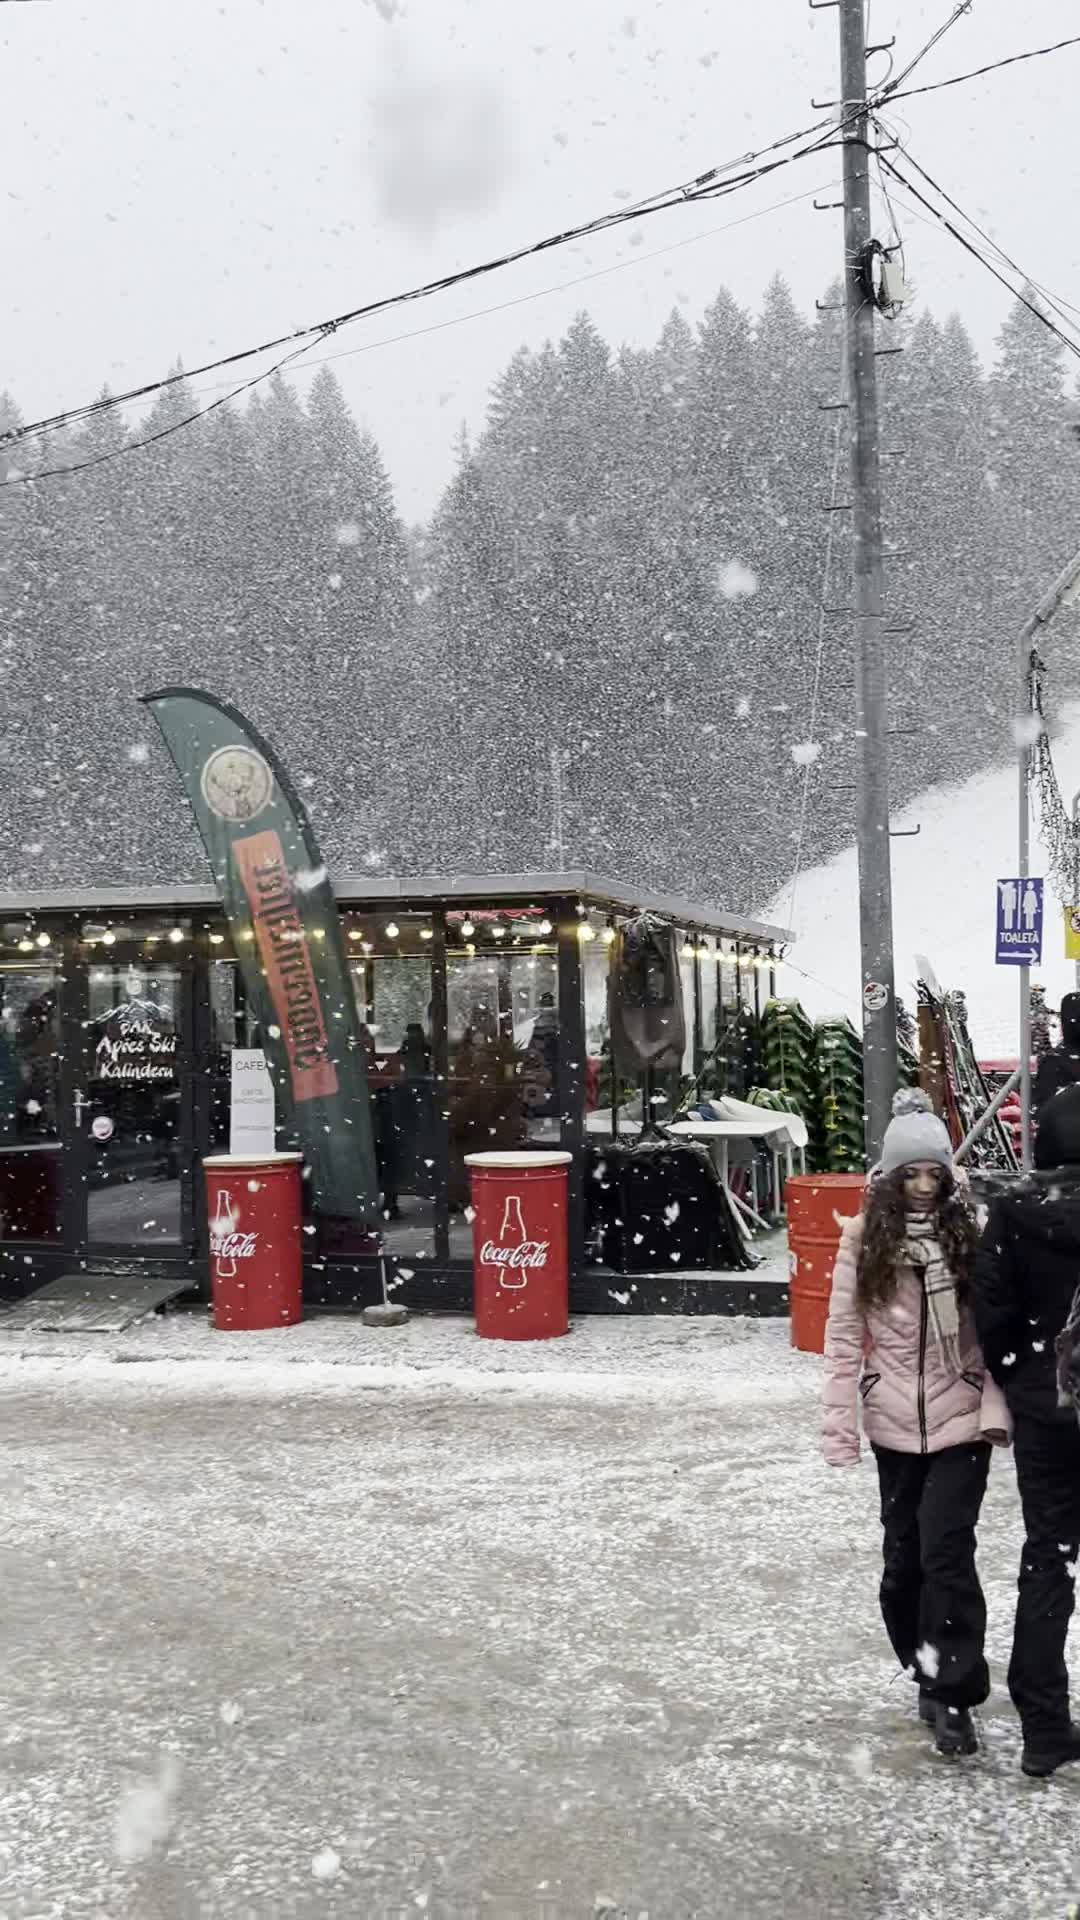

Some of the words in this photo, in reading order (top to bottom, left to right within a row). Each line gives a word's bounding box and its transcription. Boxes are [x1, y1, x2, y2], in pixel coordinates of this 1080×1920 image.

[1000, 930, 1039, 944] TOALETĂ
[149, 1031, 177, 1053] Ski
[235, 1060, 268, 1071] CAFE
[480, 1240, 550, 1268] Coca-Cola
